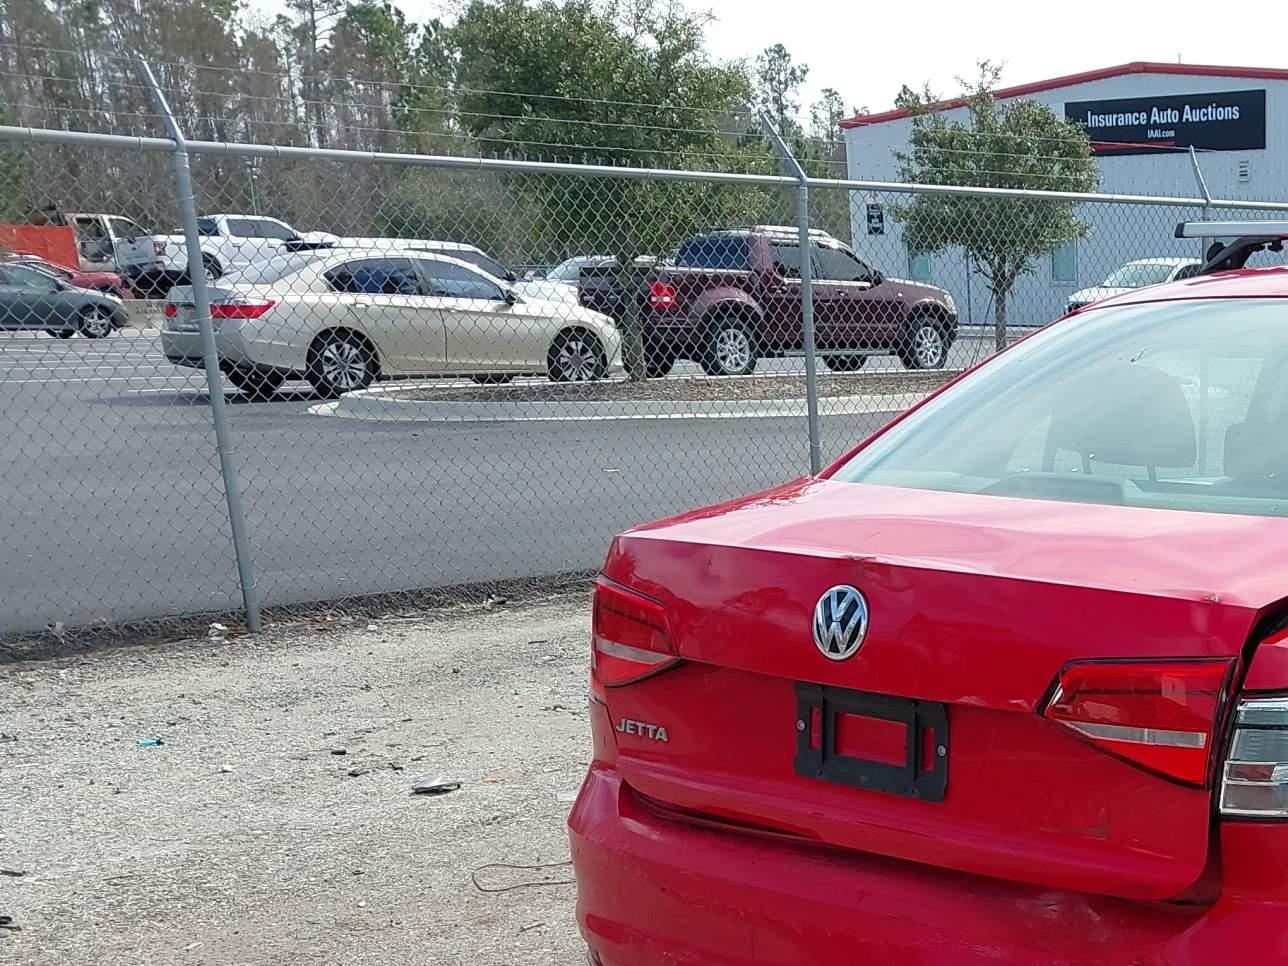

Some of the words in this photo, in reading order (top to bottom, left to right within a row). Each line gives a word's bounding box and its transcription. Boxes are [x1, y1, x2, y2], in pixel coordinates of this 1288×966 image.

[1087, 110, 1147, 128] Insurance
[1150, 106, 1179, 125] Auto
[1182, 102, 1240, 122] Auctions
[615, 718, 668, 742] JETTA
